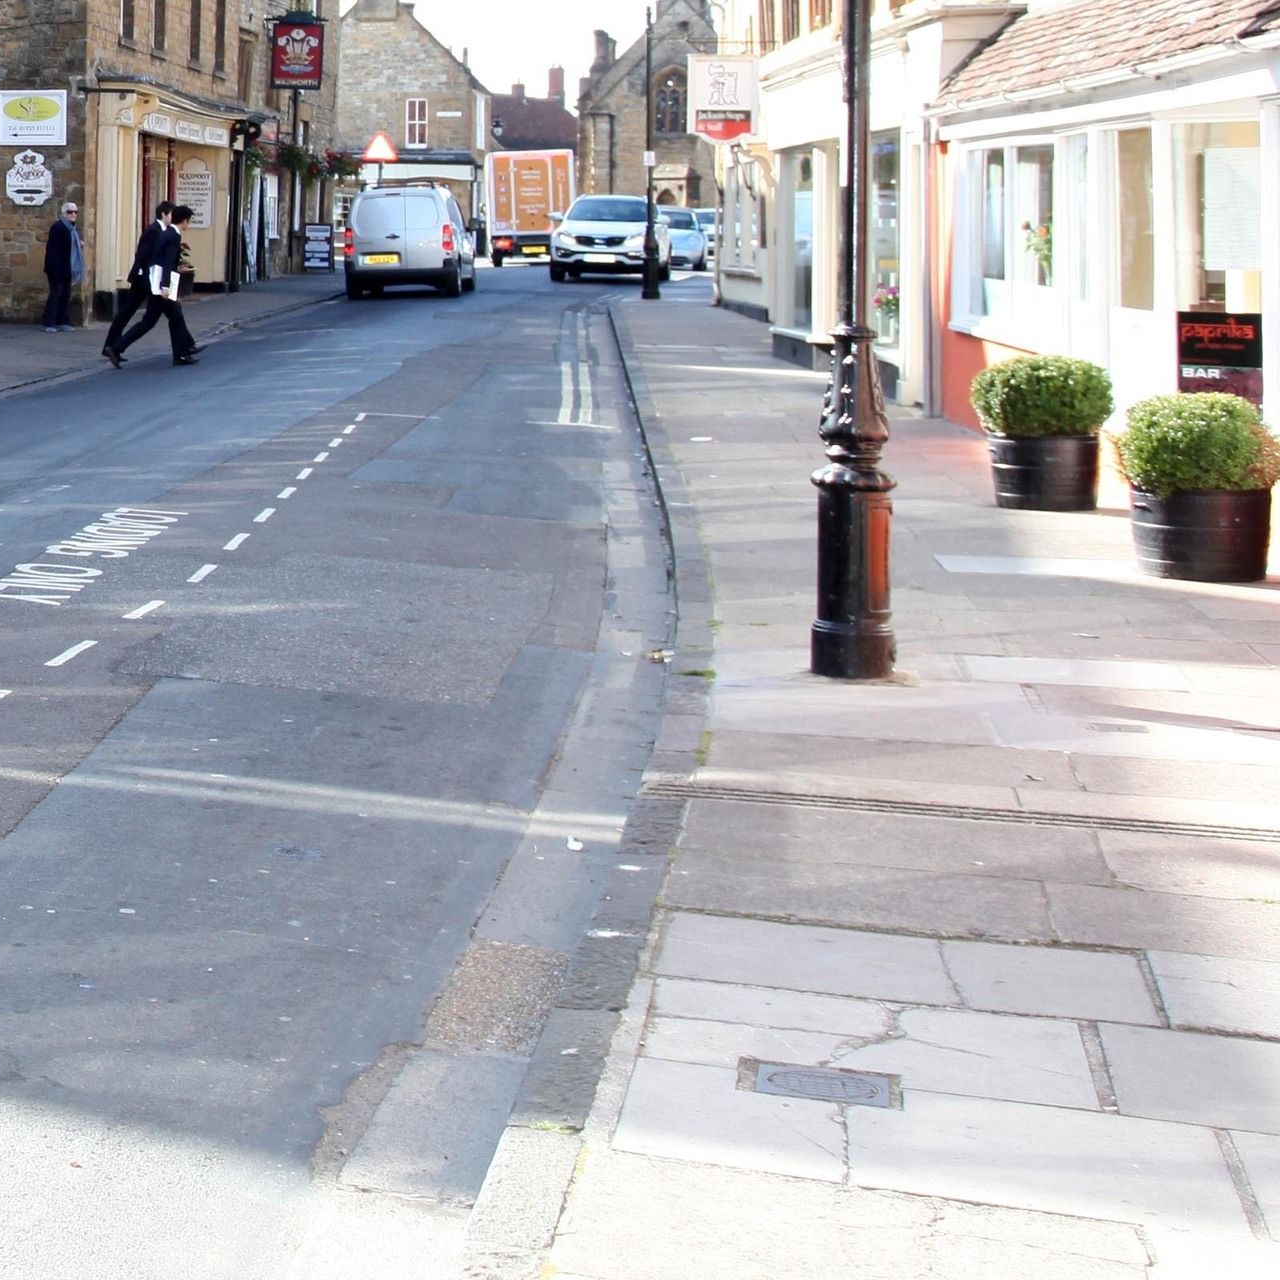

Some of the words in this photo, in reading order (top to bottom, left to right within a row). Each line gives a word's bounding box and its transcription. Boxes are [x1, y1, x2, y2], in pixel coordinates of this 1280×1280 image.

[1181, 317, 1255, 343] paprika
[1182, 368, 1220, 379] BAR
[46, 507, 189, 558] LOADING
